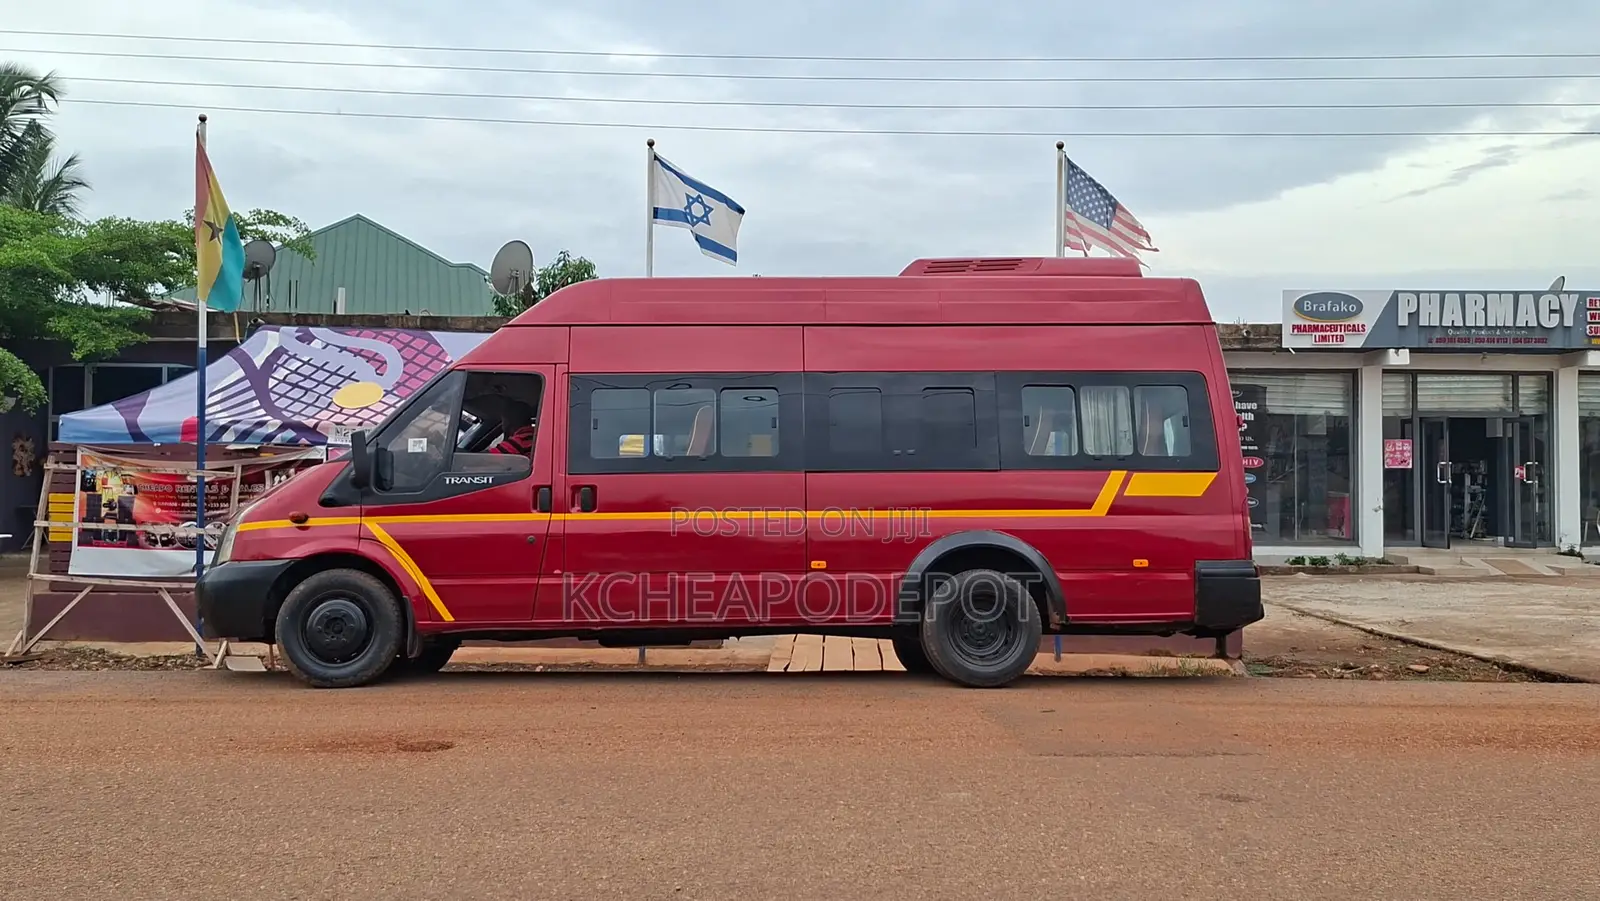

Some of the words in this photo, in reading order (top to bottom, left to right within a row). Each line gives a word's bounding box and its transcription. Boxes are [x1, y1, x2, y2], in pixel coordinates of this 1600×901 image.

[1303, 300, 1357, 312] Brafako
[1397, 293, 1579, 328] PHARMACY
[1291, 324, 1366, 333] PHARMACEUTICALS
[1588, 326, 1600, 335] SU
[1314, 334, 1345, 343] LIMITED
[444, 476, 495, 484] TRANSIT
